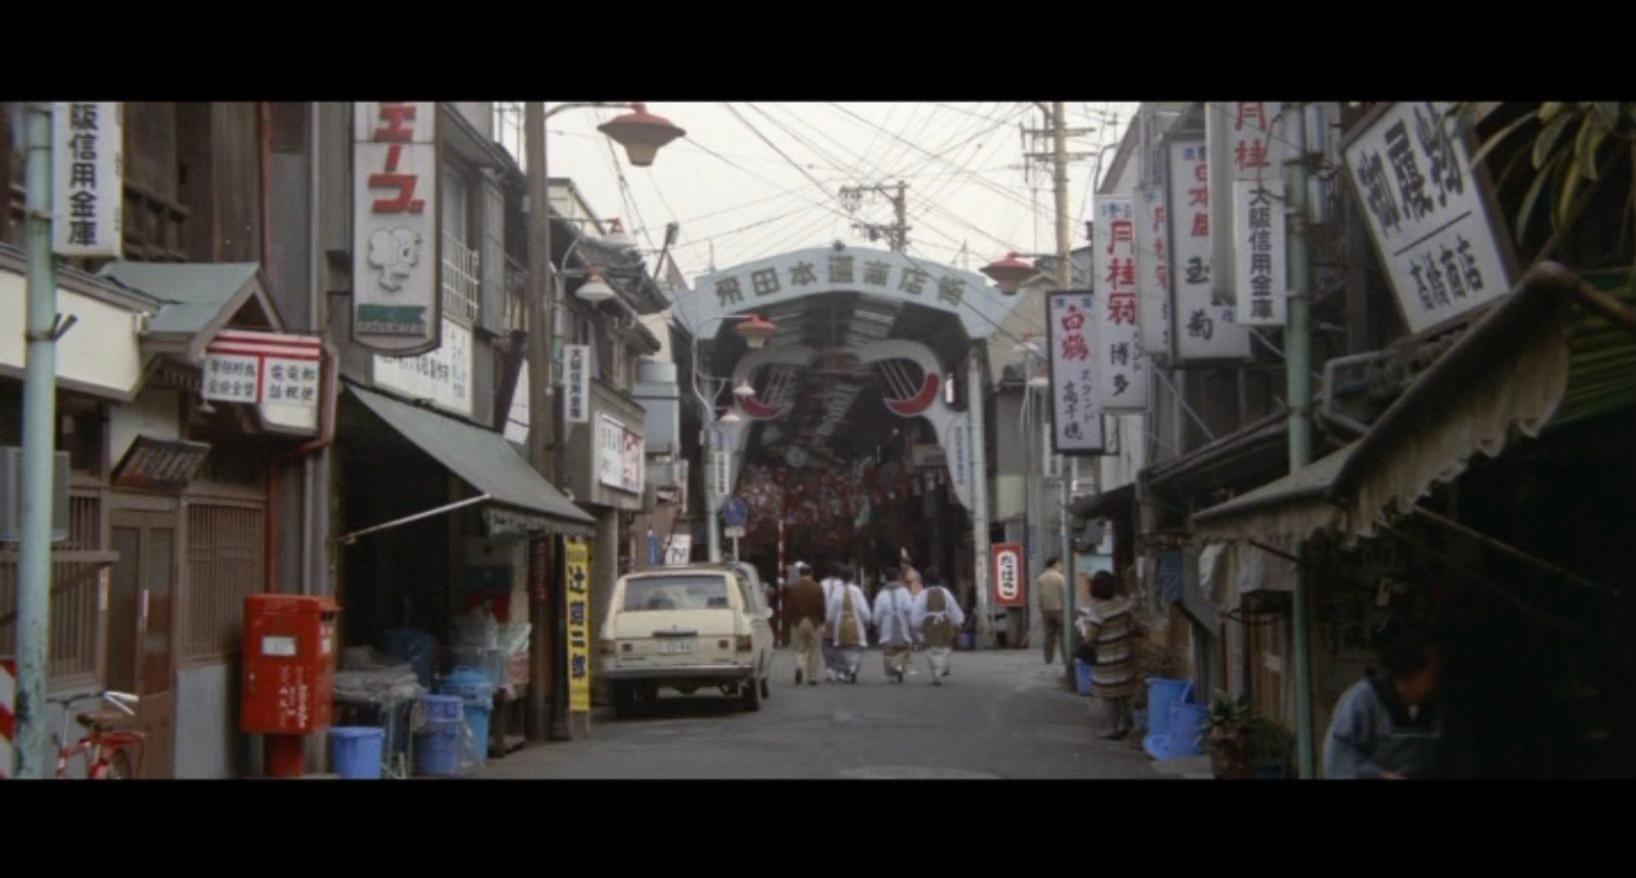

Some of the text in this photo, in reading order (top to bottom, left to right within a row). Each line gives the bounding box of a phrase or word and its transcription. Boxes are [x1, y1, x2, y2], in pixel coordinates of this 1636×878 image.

[1234, 102, 1271, 181] 月桂
[1105, 219, 1137, 327] 月桂冠
[1248, 187, 1275, 319] 大阪信用金庫
[1000, 554, 1016, 598] たばこ
